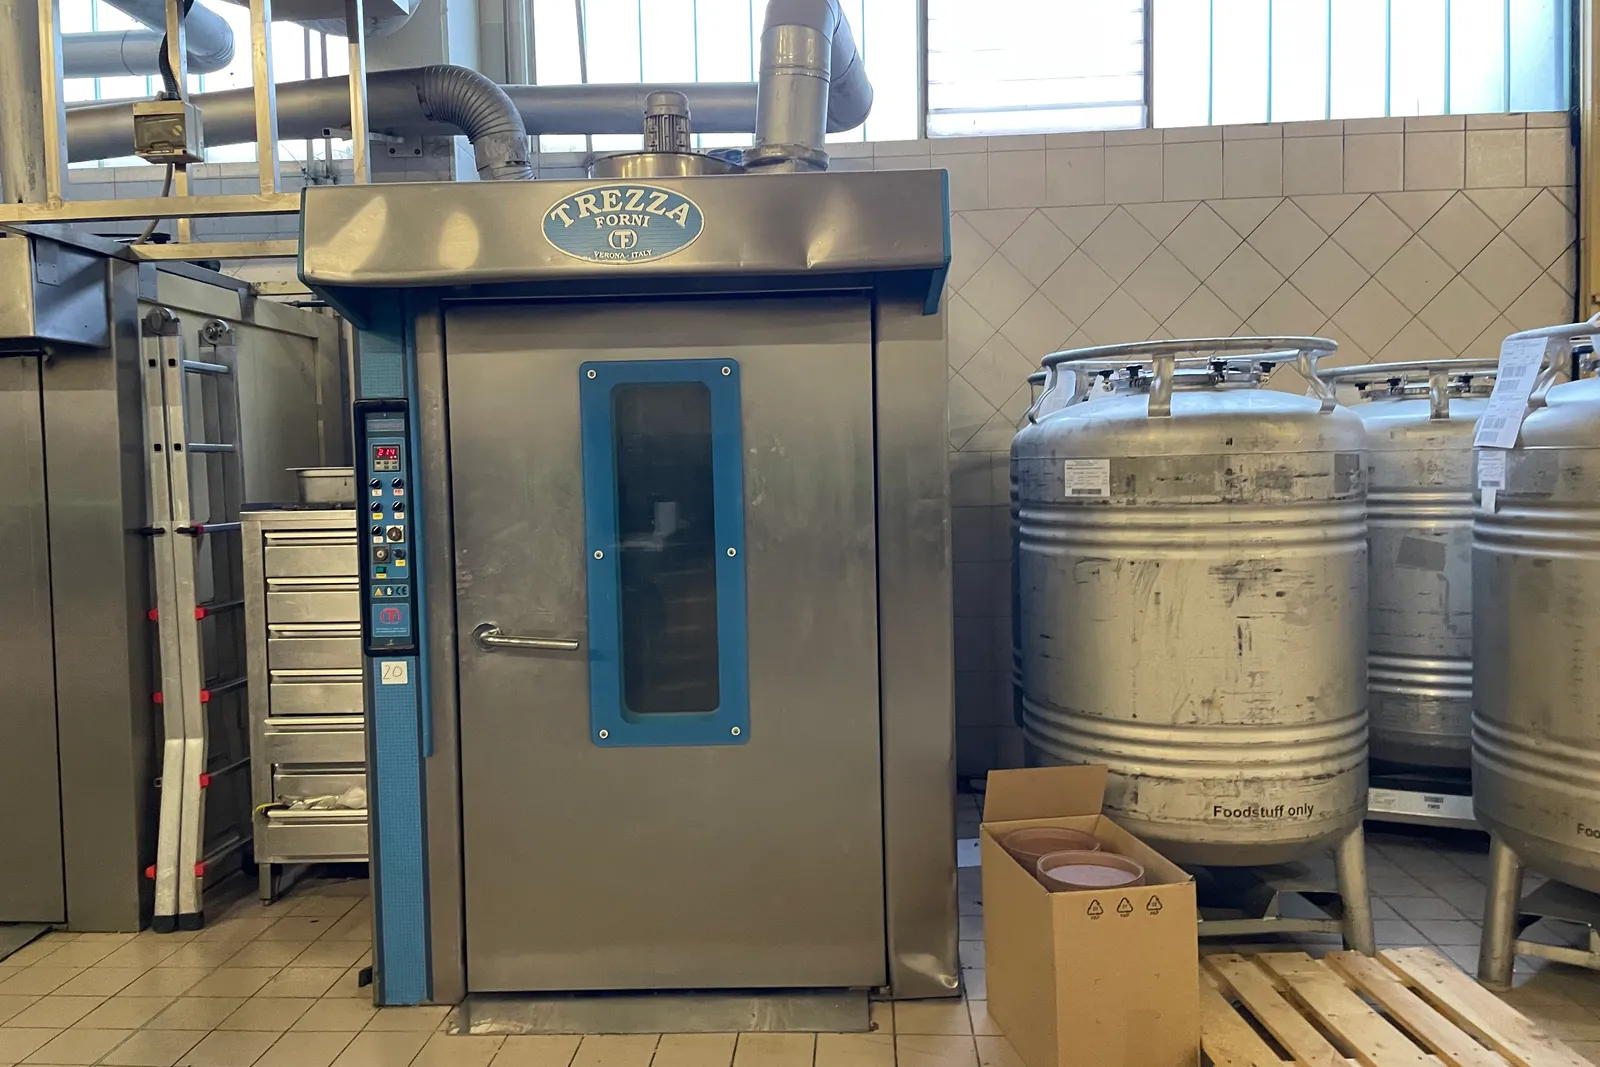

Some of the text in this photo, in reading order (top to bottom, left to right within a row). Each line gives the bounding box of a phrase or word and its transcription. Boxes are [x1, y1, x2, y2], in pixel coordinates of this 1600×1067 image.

[550, 188, 690, 229] TREZZA
[594, 213, 651, 229] FORNI
[593, 250, 625, 259] VERONA
[631, 249, 652, 258] ITALY
[376, 447, 396, 456] 214
[383, 665, 403, 680] 20
[1213, 803, 1314, 820] Foodstuff only
